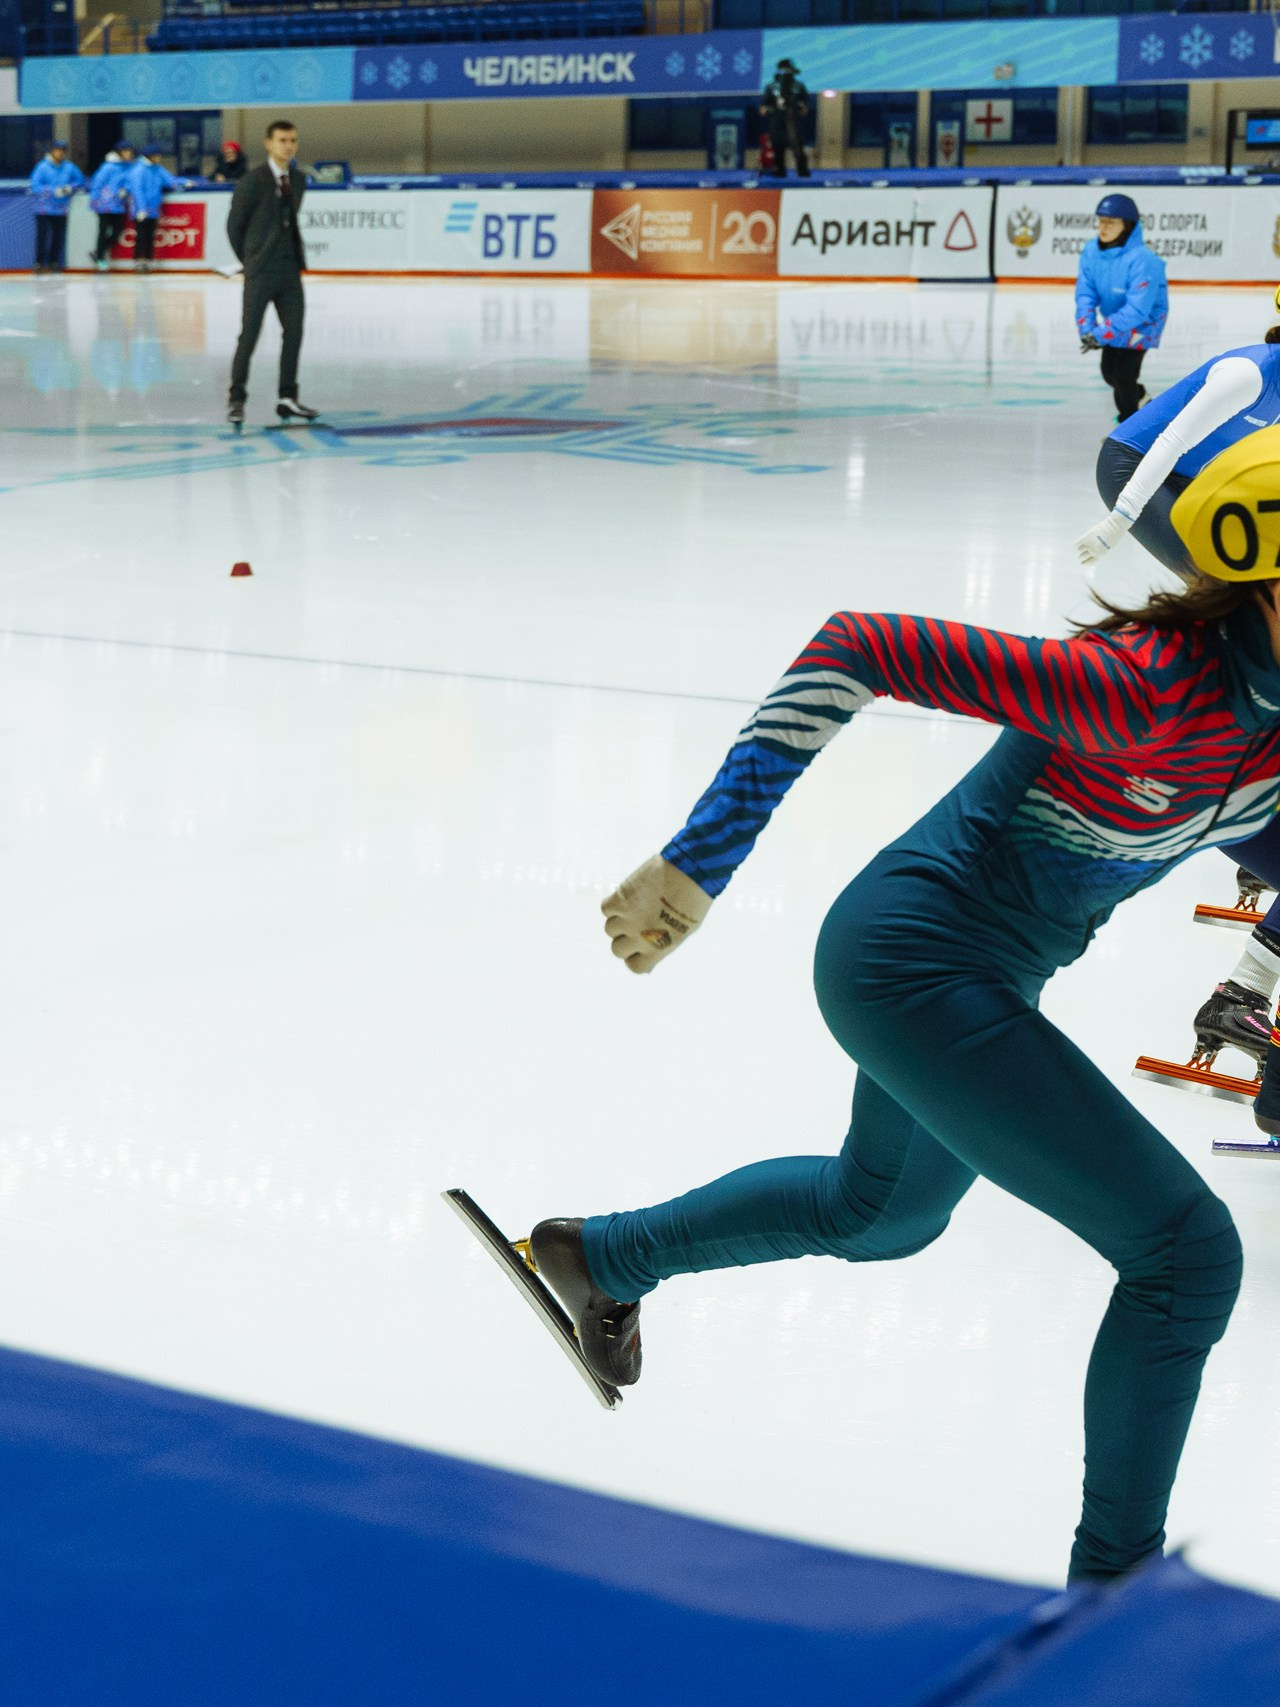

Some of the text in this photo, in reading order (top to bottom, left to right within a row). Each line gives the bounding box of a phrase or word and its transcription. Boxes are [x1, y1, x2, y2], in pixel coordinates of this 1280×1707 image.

[463, 51, 636, 87] ЧЕЛЯБИНСК
[118, 228, 200, 249] СОРТ
[482, 213, 557, 260] ВТБ
[723, 211, 776, 254] 20
[792, 211, 936, 255] Ариант
[1159, 213, 1208, 232] СПОРТА
